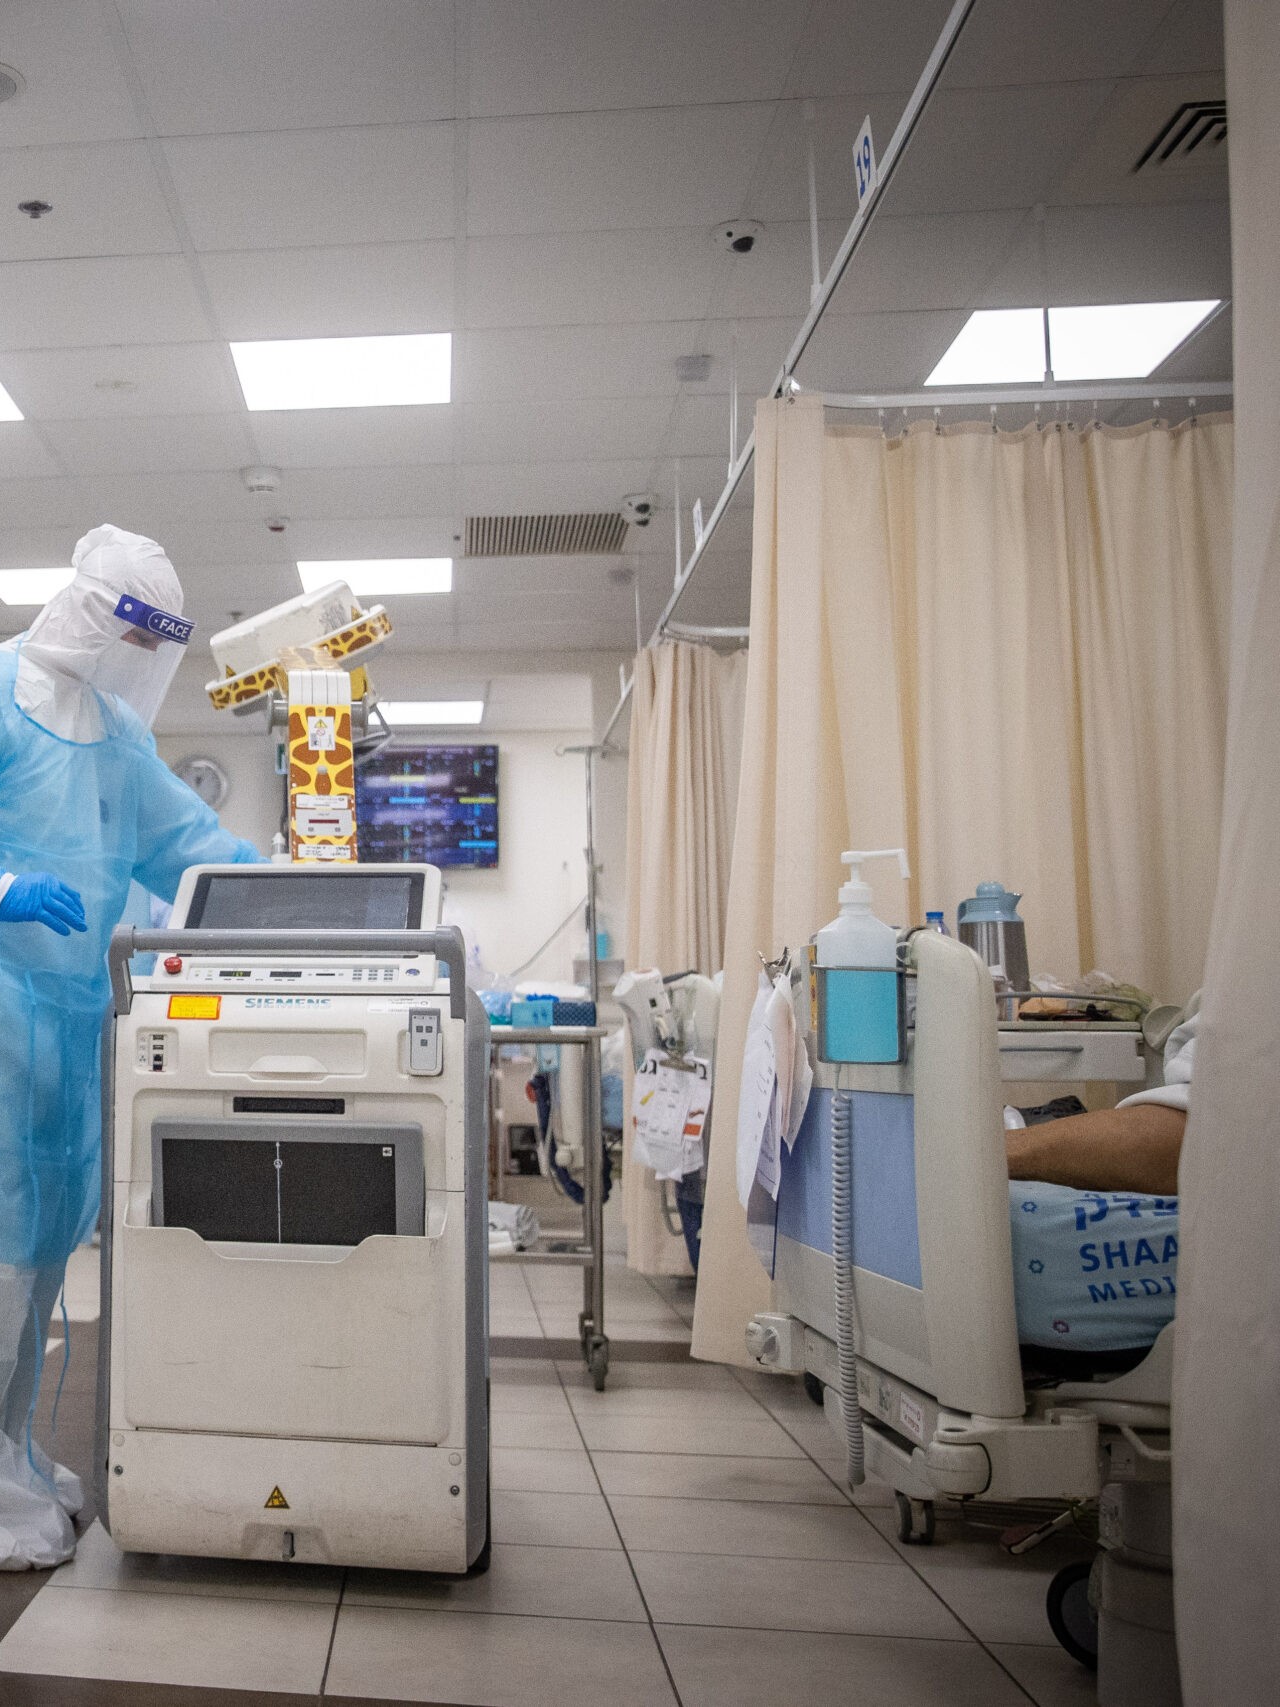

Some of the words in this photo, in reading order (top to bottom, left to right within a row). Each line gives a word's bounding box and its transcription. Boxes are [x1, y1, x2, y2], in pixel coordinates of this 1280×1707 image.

[856, 135, 871, 200] 19
[159, 618, 190, 639] FACE
[244, 997, 332, 1009] SIEMENS
